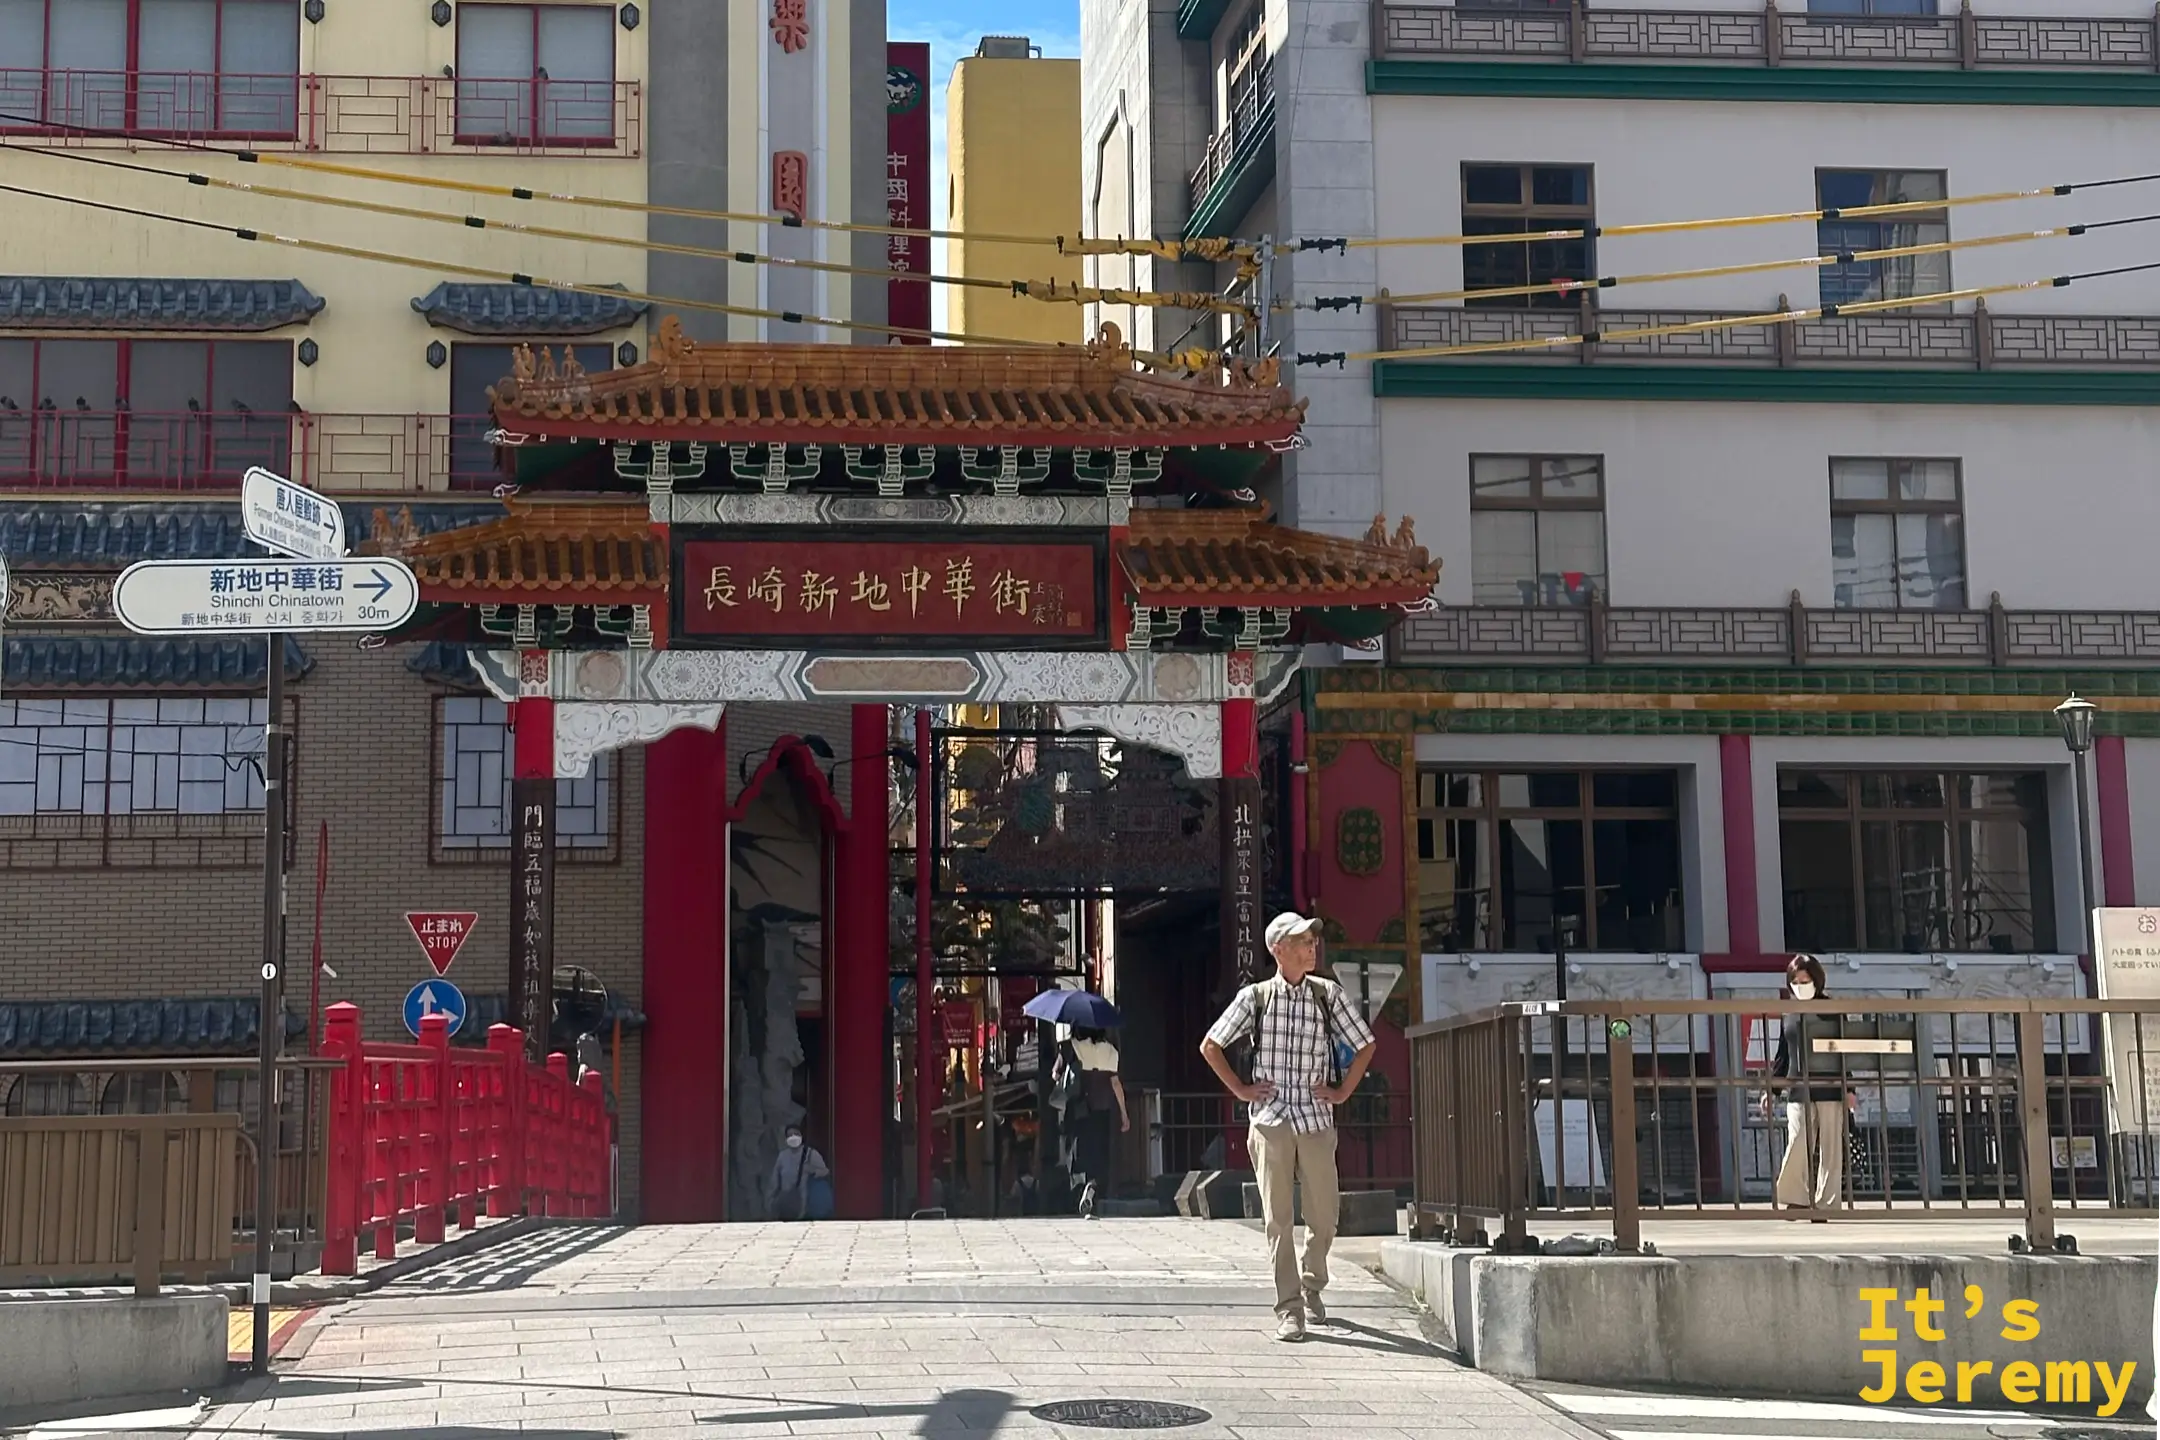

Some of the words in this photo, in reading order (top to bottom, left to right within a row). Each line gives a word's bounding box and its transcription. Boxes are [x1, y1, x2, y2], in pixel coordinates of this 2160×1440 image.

[210, 567, 344, 593] 新地中華街
[703, 556, 1031, 621] 長崎新地中華街
[211, 596, 264, 609] Shinchi
[268, 594, 344, 608] Chinatown
[181, 613, 251, 626] 新地中华街
[265, 612, 292, 624] 신치
[301, 611, 343, 624] 중화가
[357, 606, 390, 620] 30m
[420, 918, 463, 933] 止まれ
[2138, 914, 2157, 933] お
[427, 936, 457, 948] STOP
